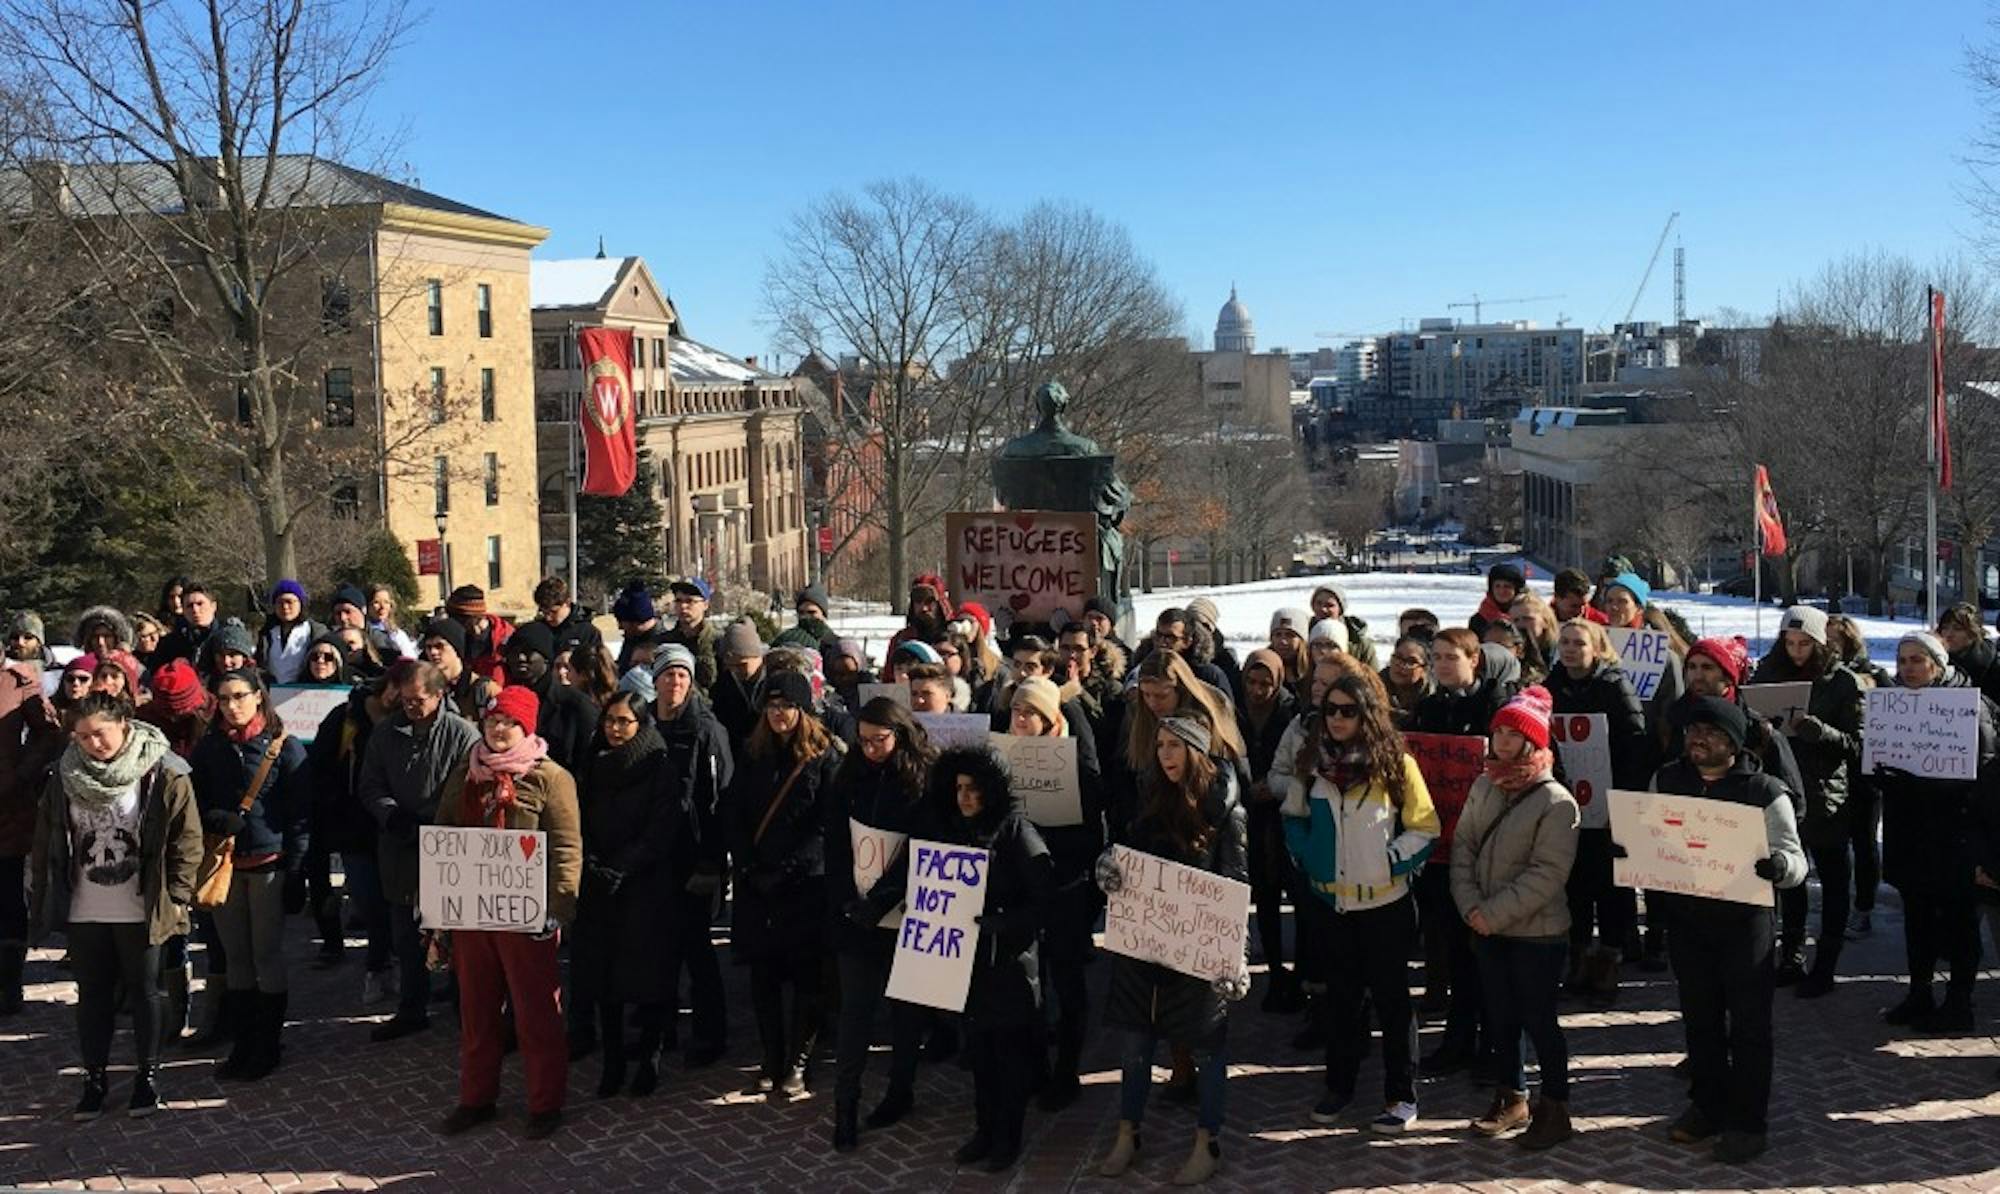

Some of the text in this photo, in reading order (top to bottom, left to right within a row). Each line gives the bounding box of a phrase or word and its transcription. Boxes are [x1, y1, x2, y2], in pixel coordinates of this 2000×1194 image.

[595, 383, 620, 418] W
[964, 526, 1086, 555] REFUGEES
[962, 562, 1085, 596] WELCOME
[1621, 632, 1668, 664] ARE
[1869, 692, 1921, 715] FIRST
[1552, 716, 1591, 742] NO
[1922, 754, 1966, 775] OUT!
[423, 830, 468, 857] OPEN
[479, 833, 514, 861] YOUR
[436, 861, 534, 889] TO THOSE
[916, 848, 986, 886] FACTS
[1153, 860, 1169, 892] I
[441, 893, 540, 924] IN NEED
[915, 885, 956, 915] NOT
[902, 917, 964, 958] FEAR
[1199, 935, 1222, 954] on
